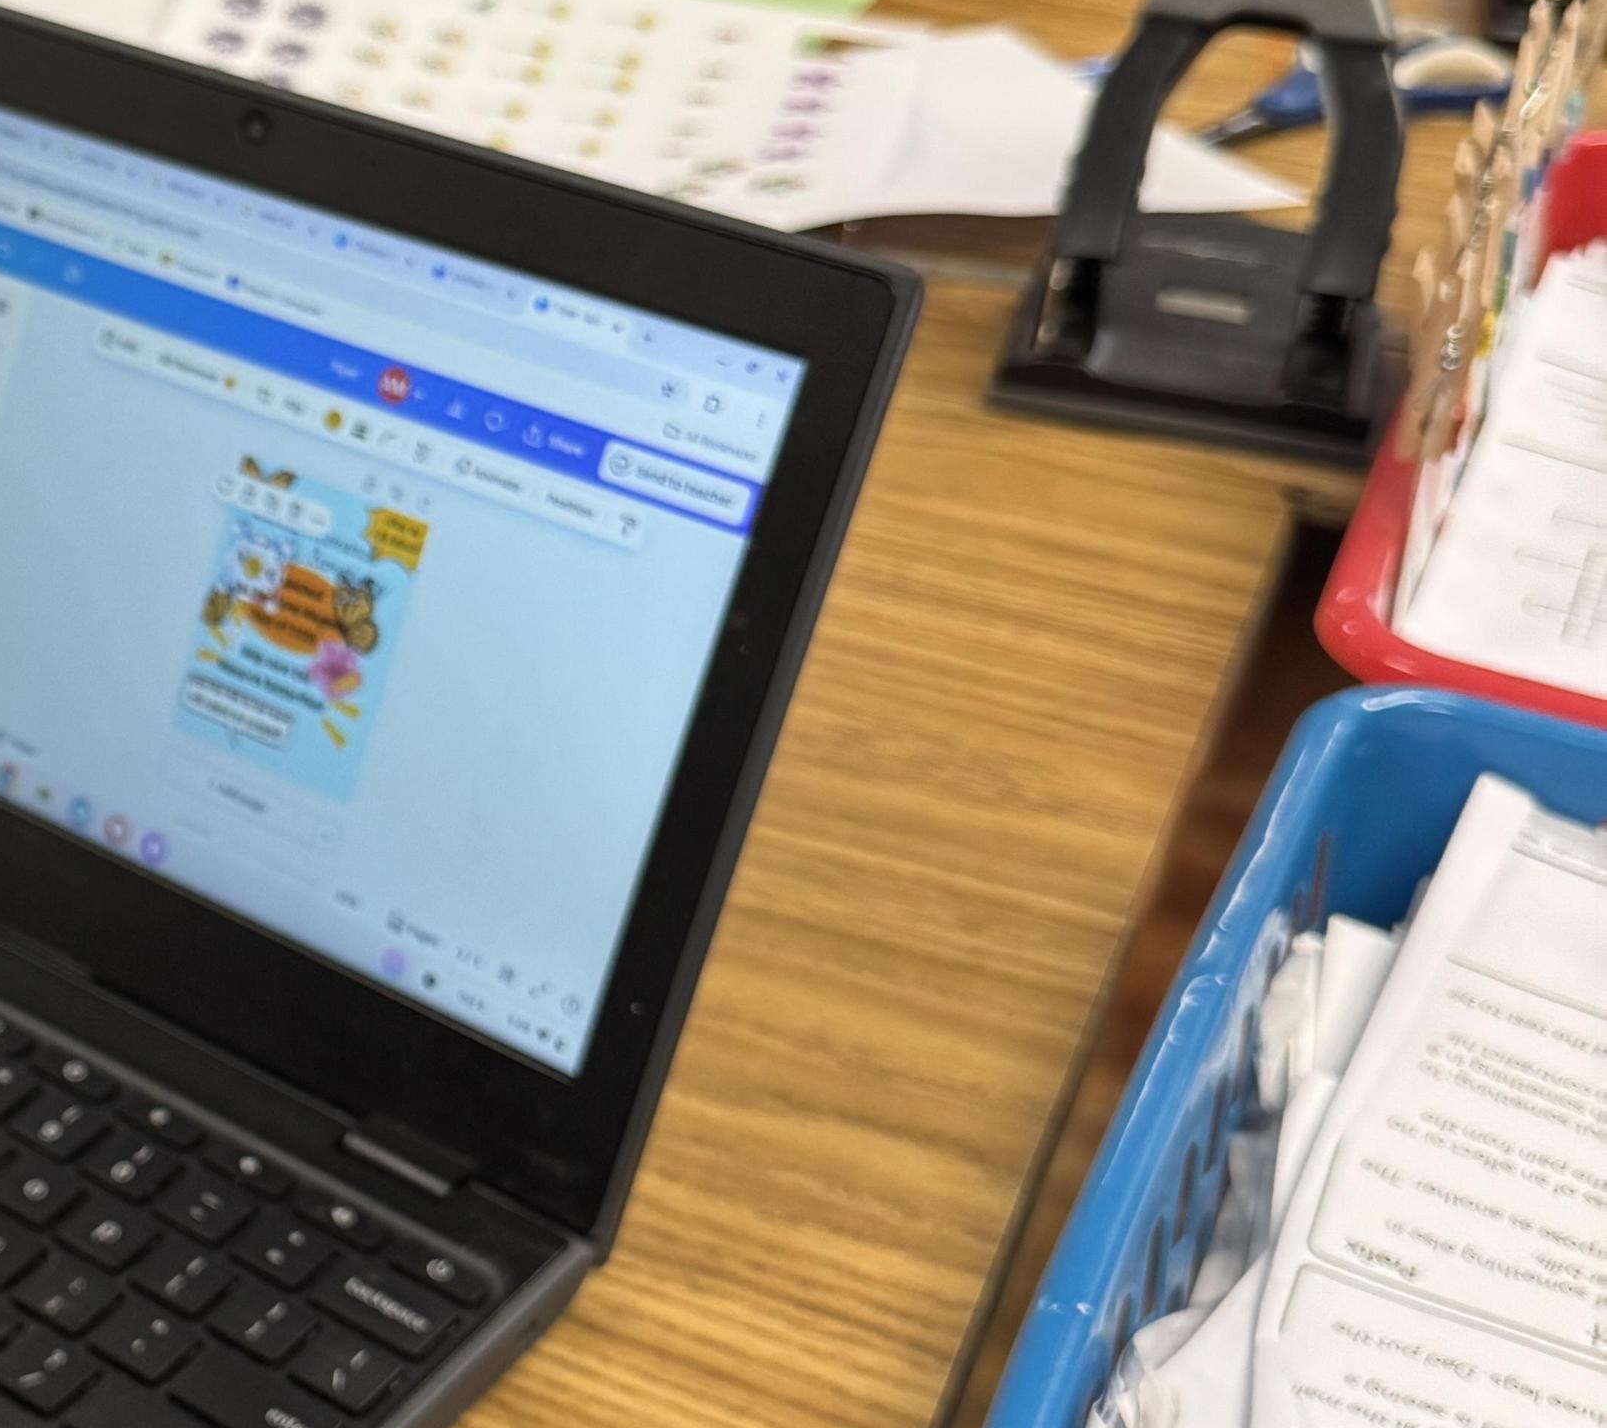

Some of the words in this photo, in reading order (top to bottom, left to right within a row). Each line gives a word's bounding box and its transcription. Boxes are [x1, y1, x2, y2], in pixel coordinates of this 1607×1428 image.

[1360, 1158, 1401, 1188] The
[1340, 1239, 1419, 1282] Prefix
[1460, 1245, 1588, 1300] something
[1330, 1321, 1373, 1345] the
[1376, 1336, 1422, 1359] put
[1423, 1352, 1477, 1379] Dad
[1346, 1403, 1389, 1427] the
